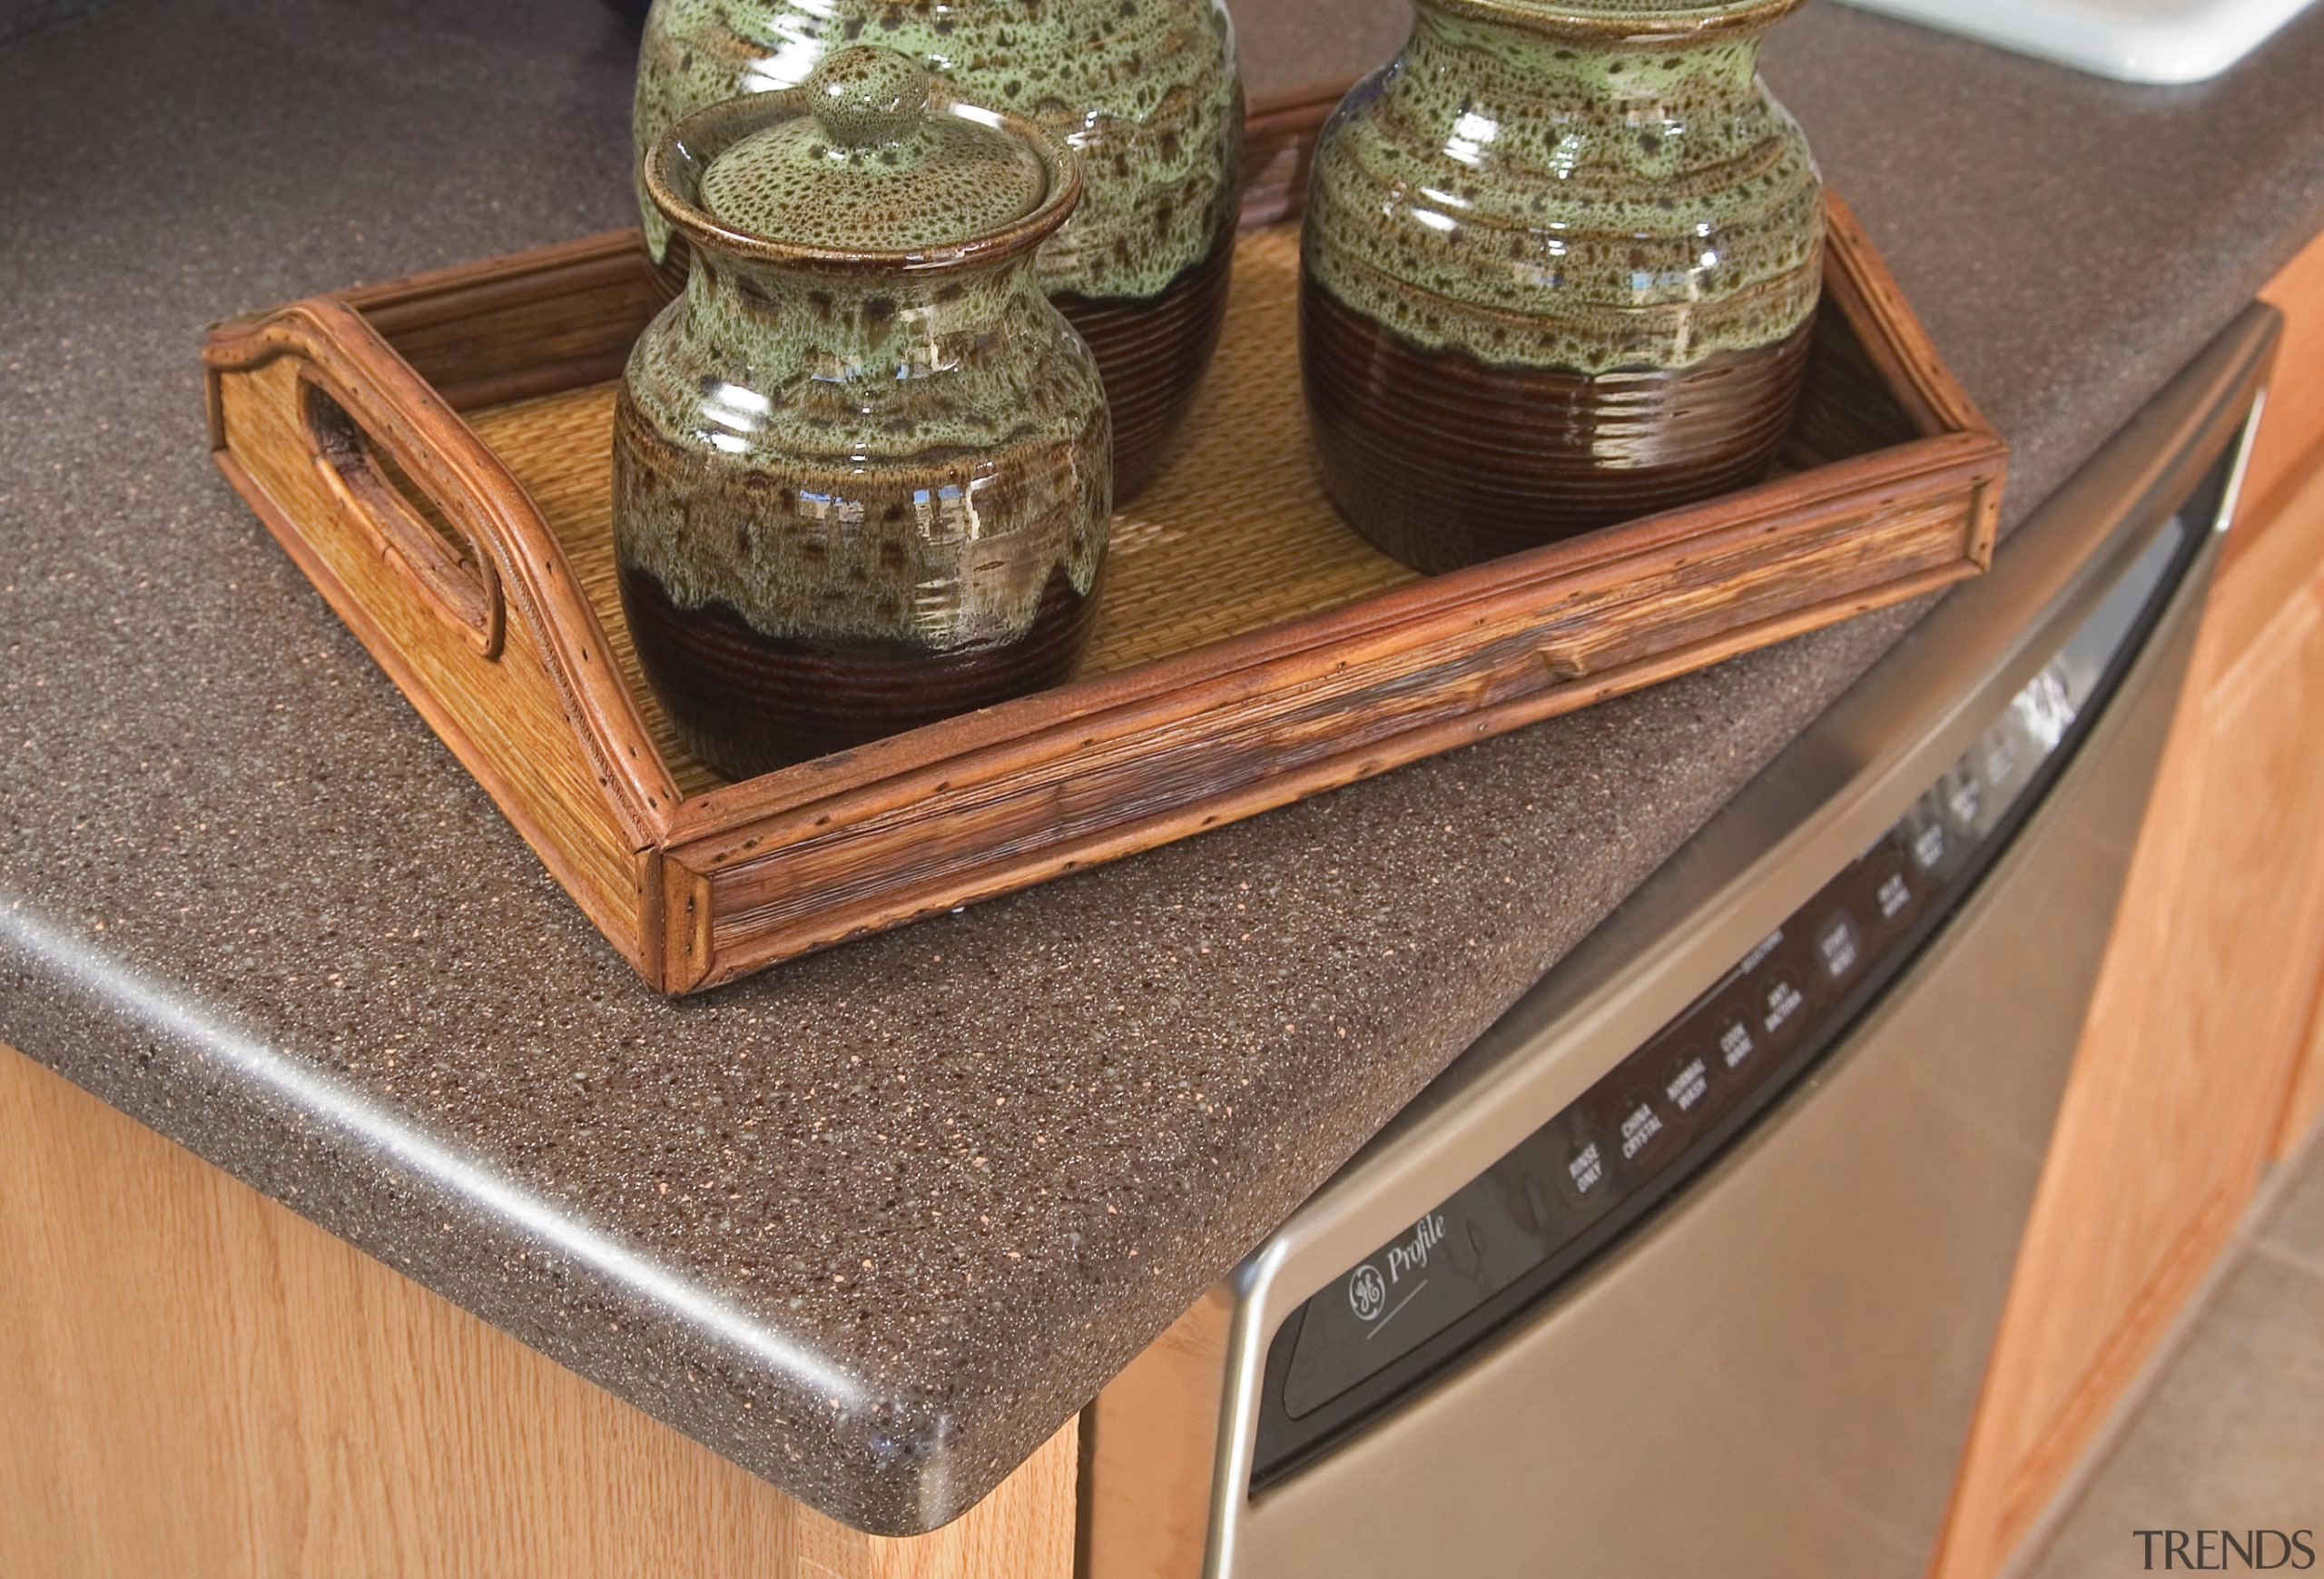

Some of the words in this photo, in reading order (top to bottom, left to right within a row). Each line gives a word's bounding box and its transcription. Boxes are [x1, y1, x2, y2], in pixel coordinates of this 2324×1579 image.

[1666, 1056, 1707, 1102] NORMAL
[1678, 1075, 1708, 1110] WASH
[1620, 1101, 1652, 1139] CHINA
[1622, 1114, 1664, 1160] CRYSTAL
[1568, 1141, 1600, 1179] RINSE
[1576, 1160, 1603, 1194] ONLY
[1386, 1213, 1447, 1285] Profile
